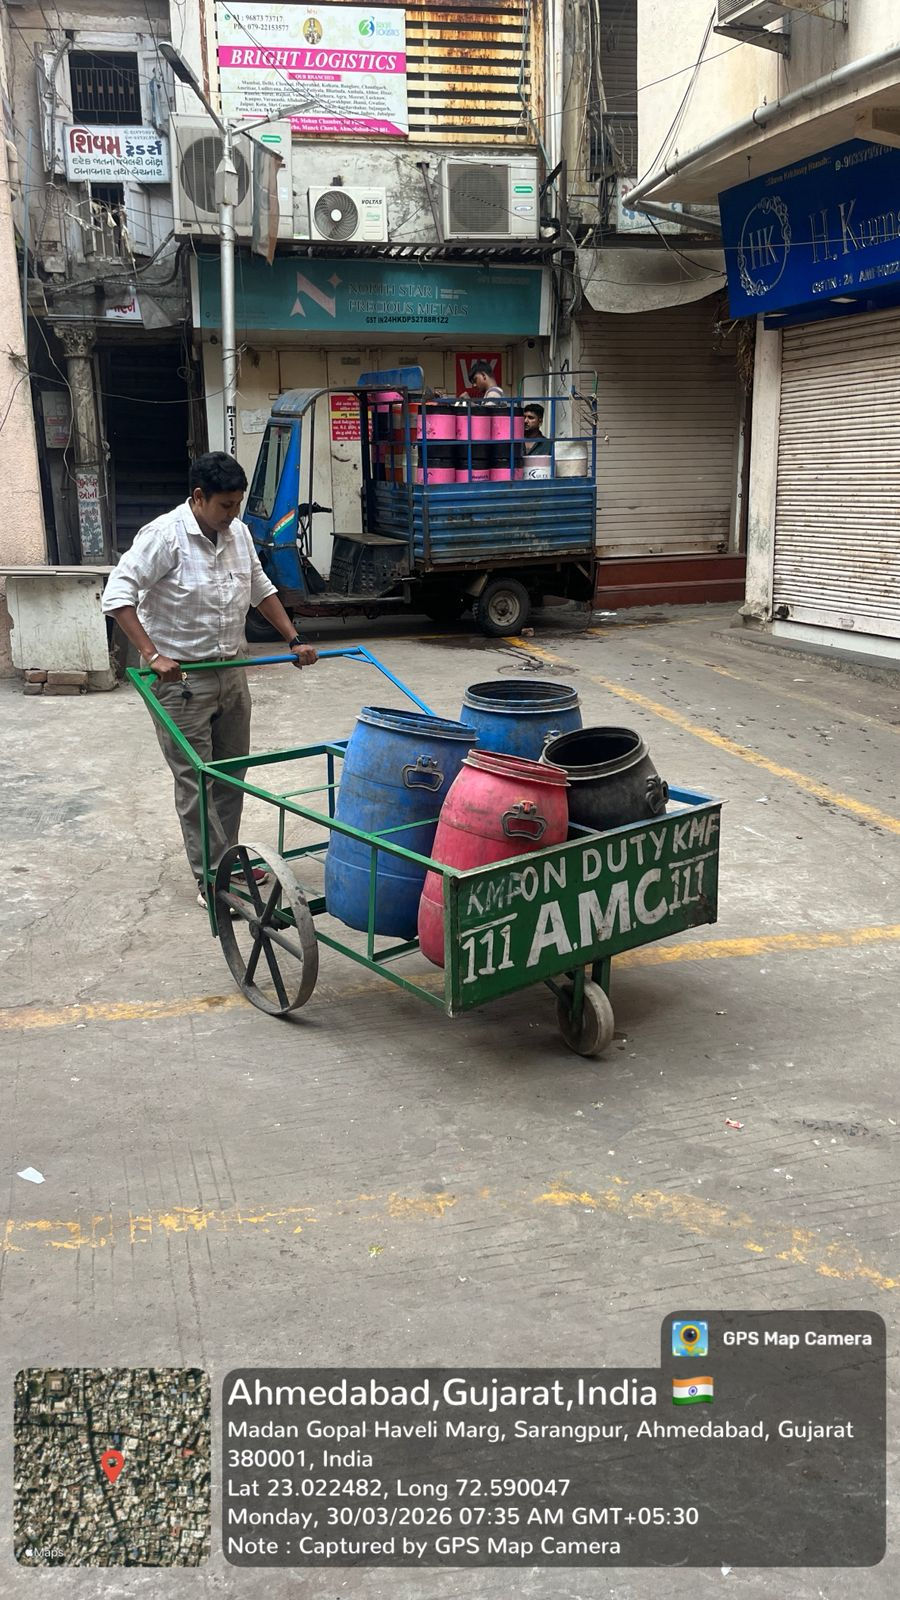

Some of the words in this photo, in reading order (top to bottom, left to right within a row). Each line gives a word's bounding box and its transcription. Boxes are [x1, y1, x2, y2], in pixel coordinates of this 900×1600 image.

[230, 49, 301, 67] BRIGHT
[303, 51, 397, 70] LOGISTICS
[69, 128, 122, 158] શિવમ્
[748, 223, 780, 271] HK
[349, 283, 396, 297] NORTH
[398, 284, 433, 298] STAR
[349, 299, 414, 315] PRECIOUS
[416, 302, 469, 317] METALS
[520, 856, 566, 902] ON
[582, 826, 667, 882] DUTY
[461, 924, 515, 984] 111
[669, 860, 706, 915] 111
